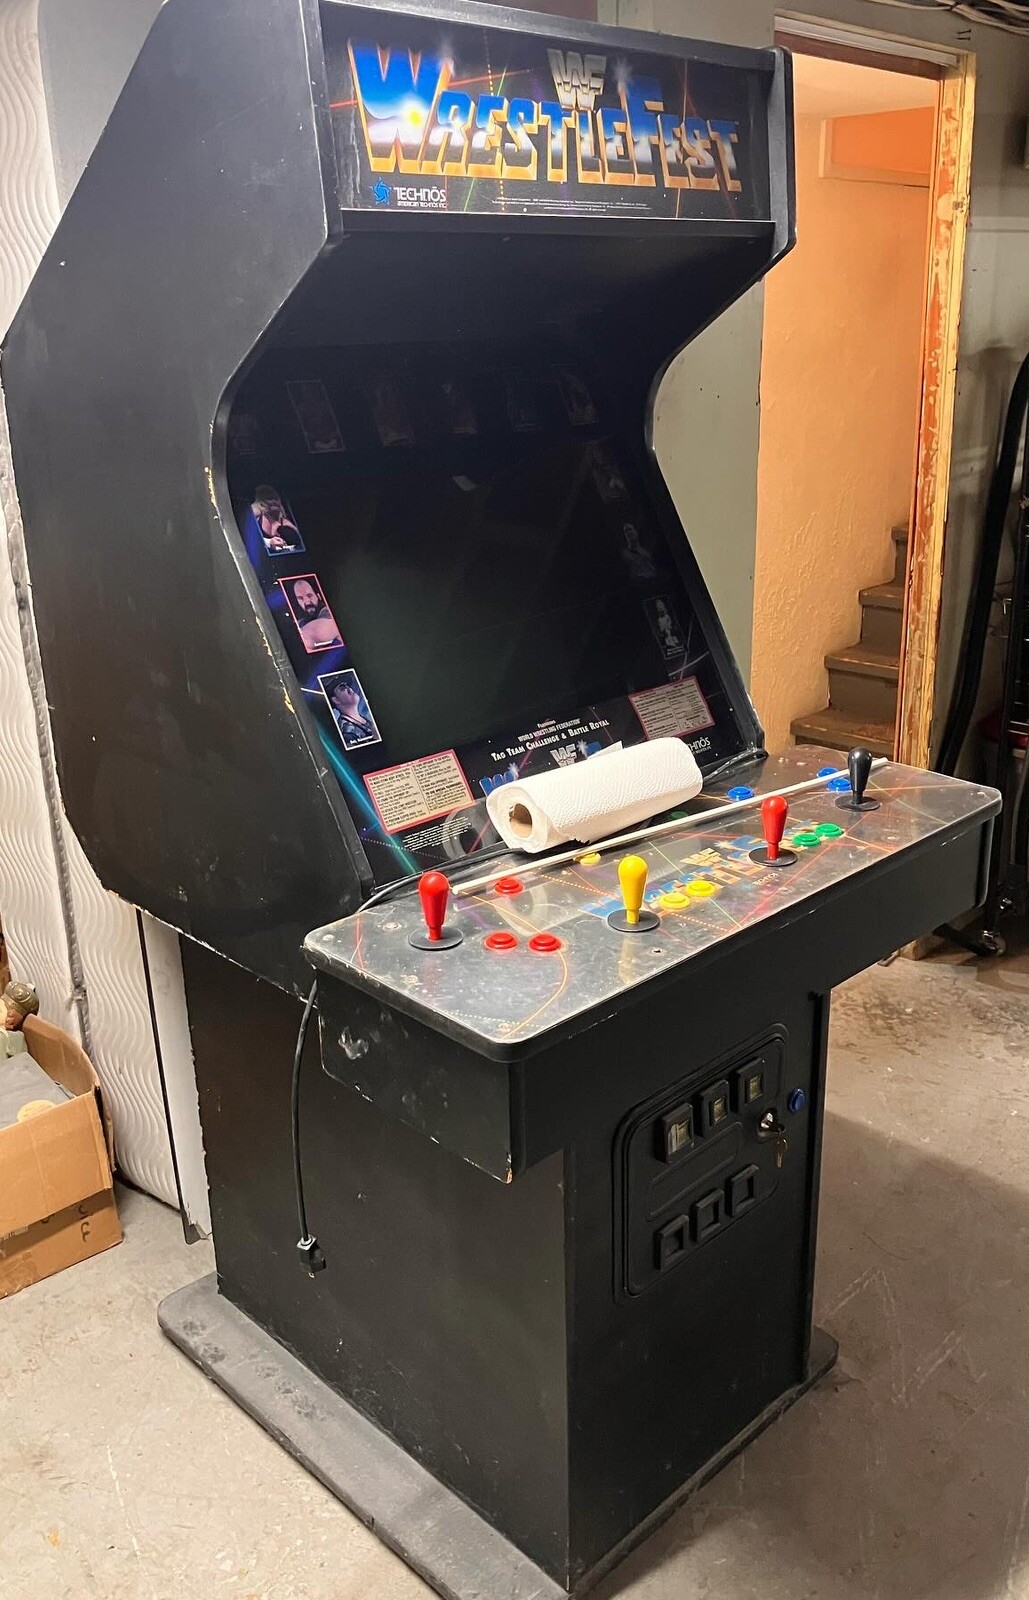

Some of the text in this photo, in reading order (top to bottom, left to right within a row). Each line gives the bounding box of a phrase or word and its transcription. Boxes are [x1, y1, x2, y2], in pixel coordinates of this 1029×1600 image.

[347, 38, 742, 192] WRESTLEFEST
[491, 719, 610, 762] TAG TEAM CHALLENGE & BATTLE ROYAL
[518, 732, 534, 742] WORLD
[532, 726, 557, 738] WRESTLING
